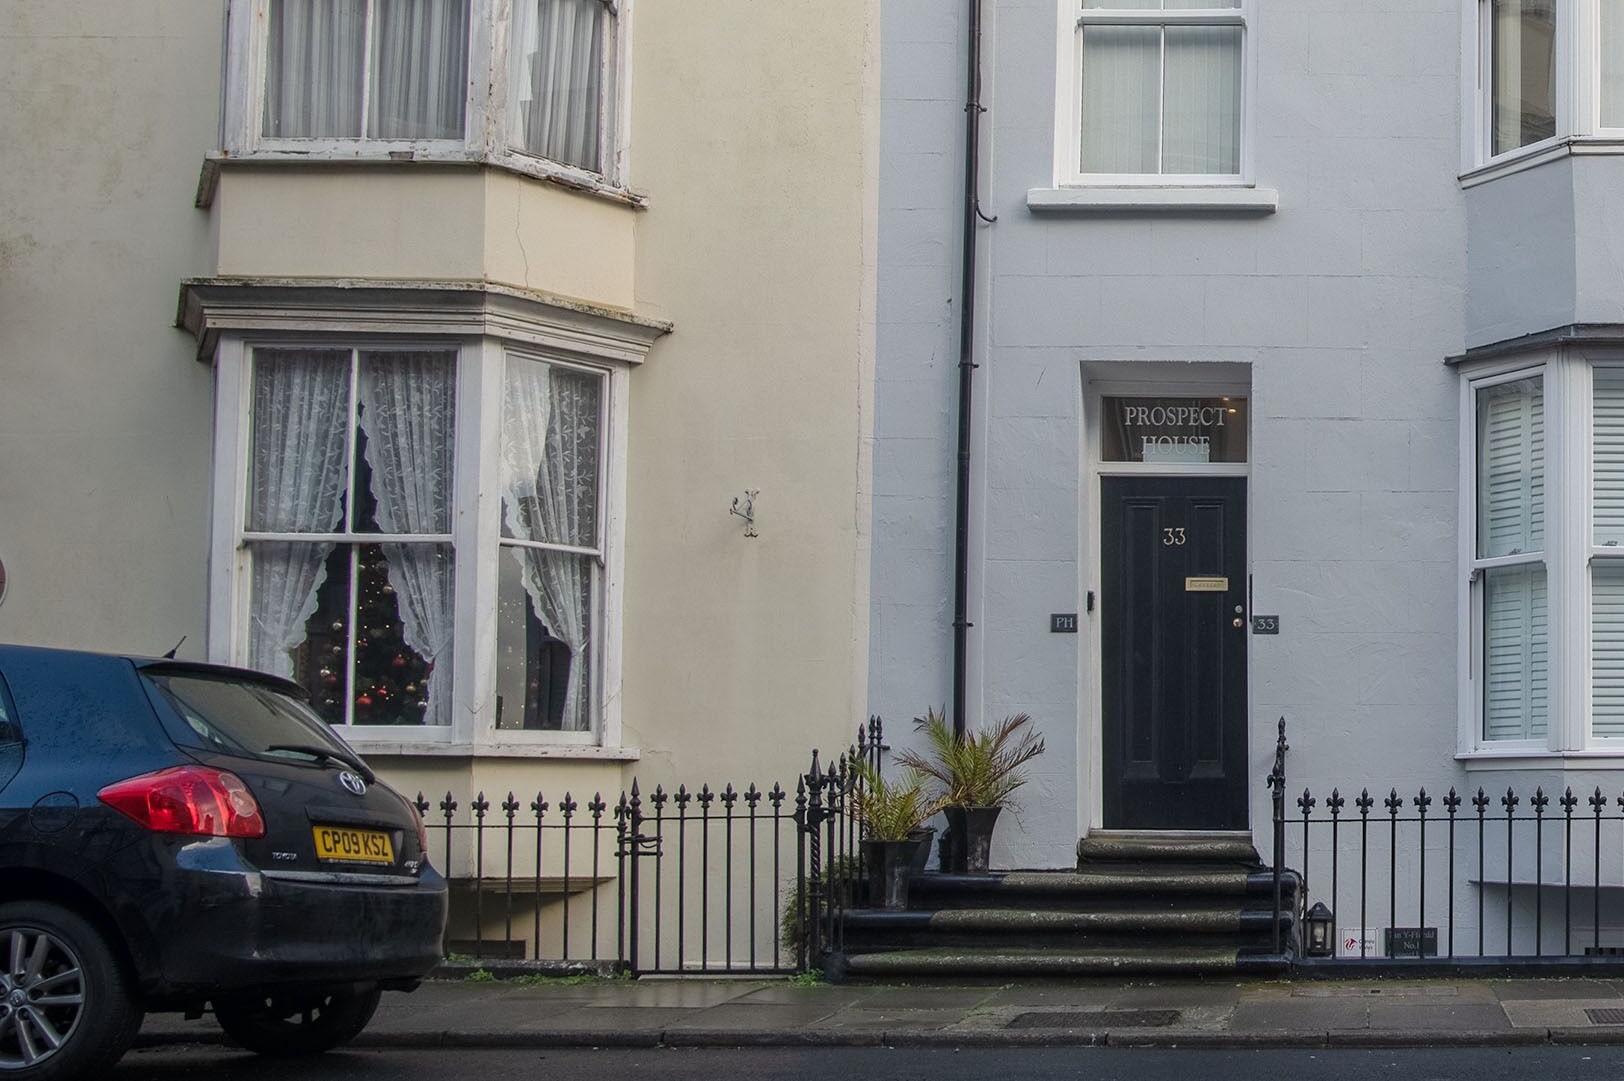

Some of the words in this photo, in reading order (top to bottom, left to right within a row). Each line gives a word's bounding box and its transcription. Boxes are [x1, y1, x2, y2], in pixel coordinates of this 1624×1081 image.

[1124, 406, 1227, 427] PROSPECT
[1140, 435, 1211, 456] HOUSE
[1163, 527, 1187, 546] 33
[1055, 616, 1074, 630] PH
[1257, 618, 1276, 631] 33
[321, 830, 361, 855] CP09
[363, 833, 389, 857] KSZ
